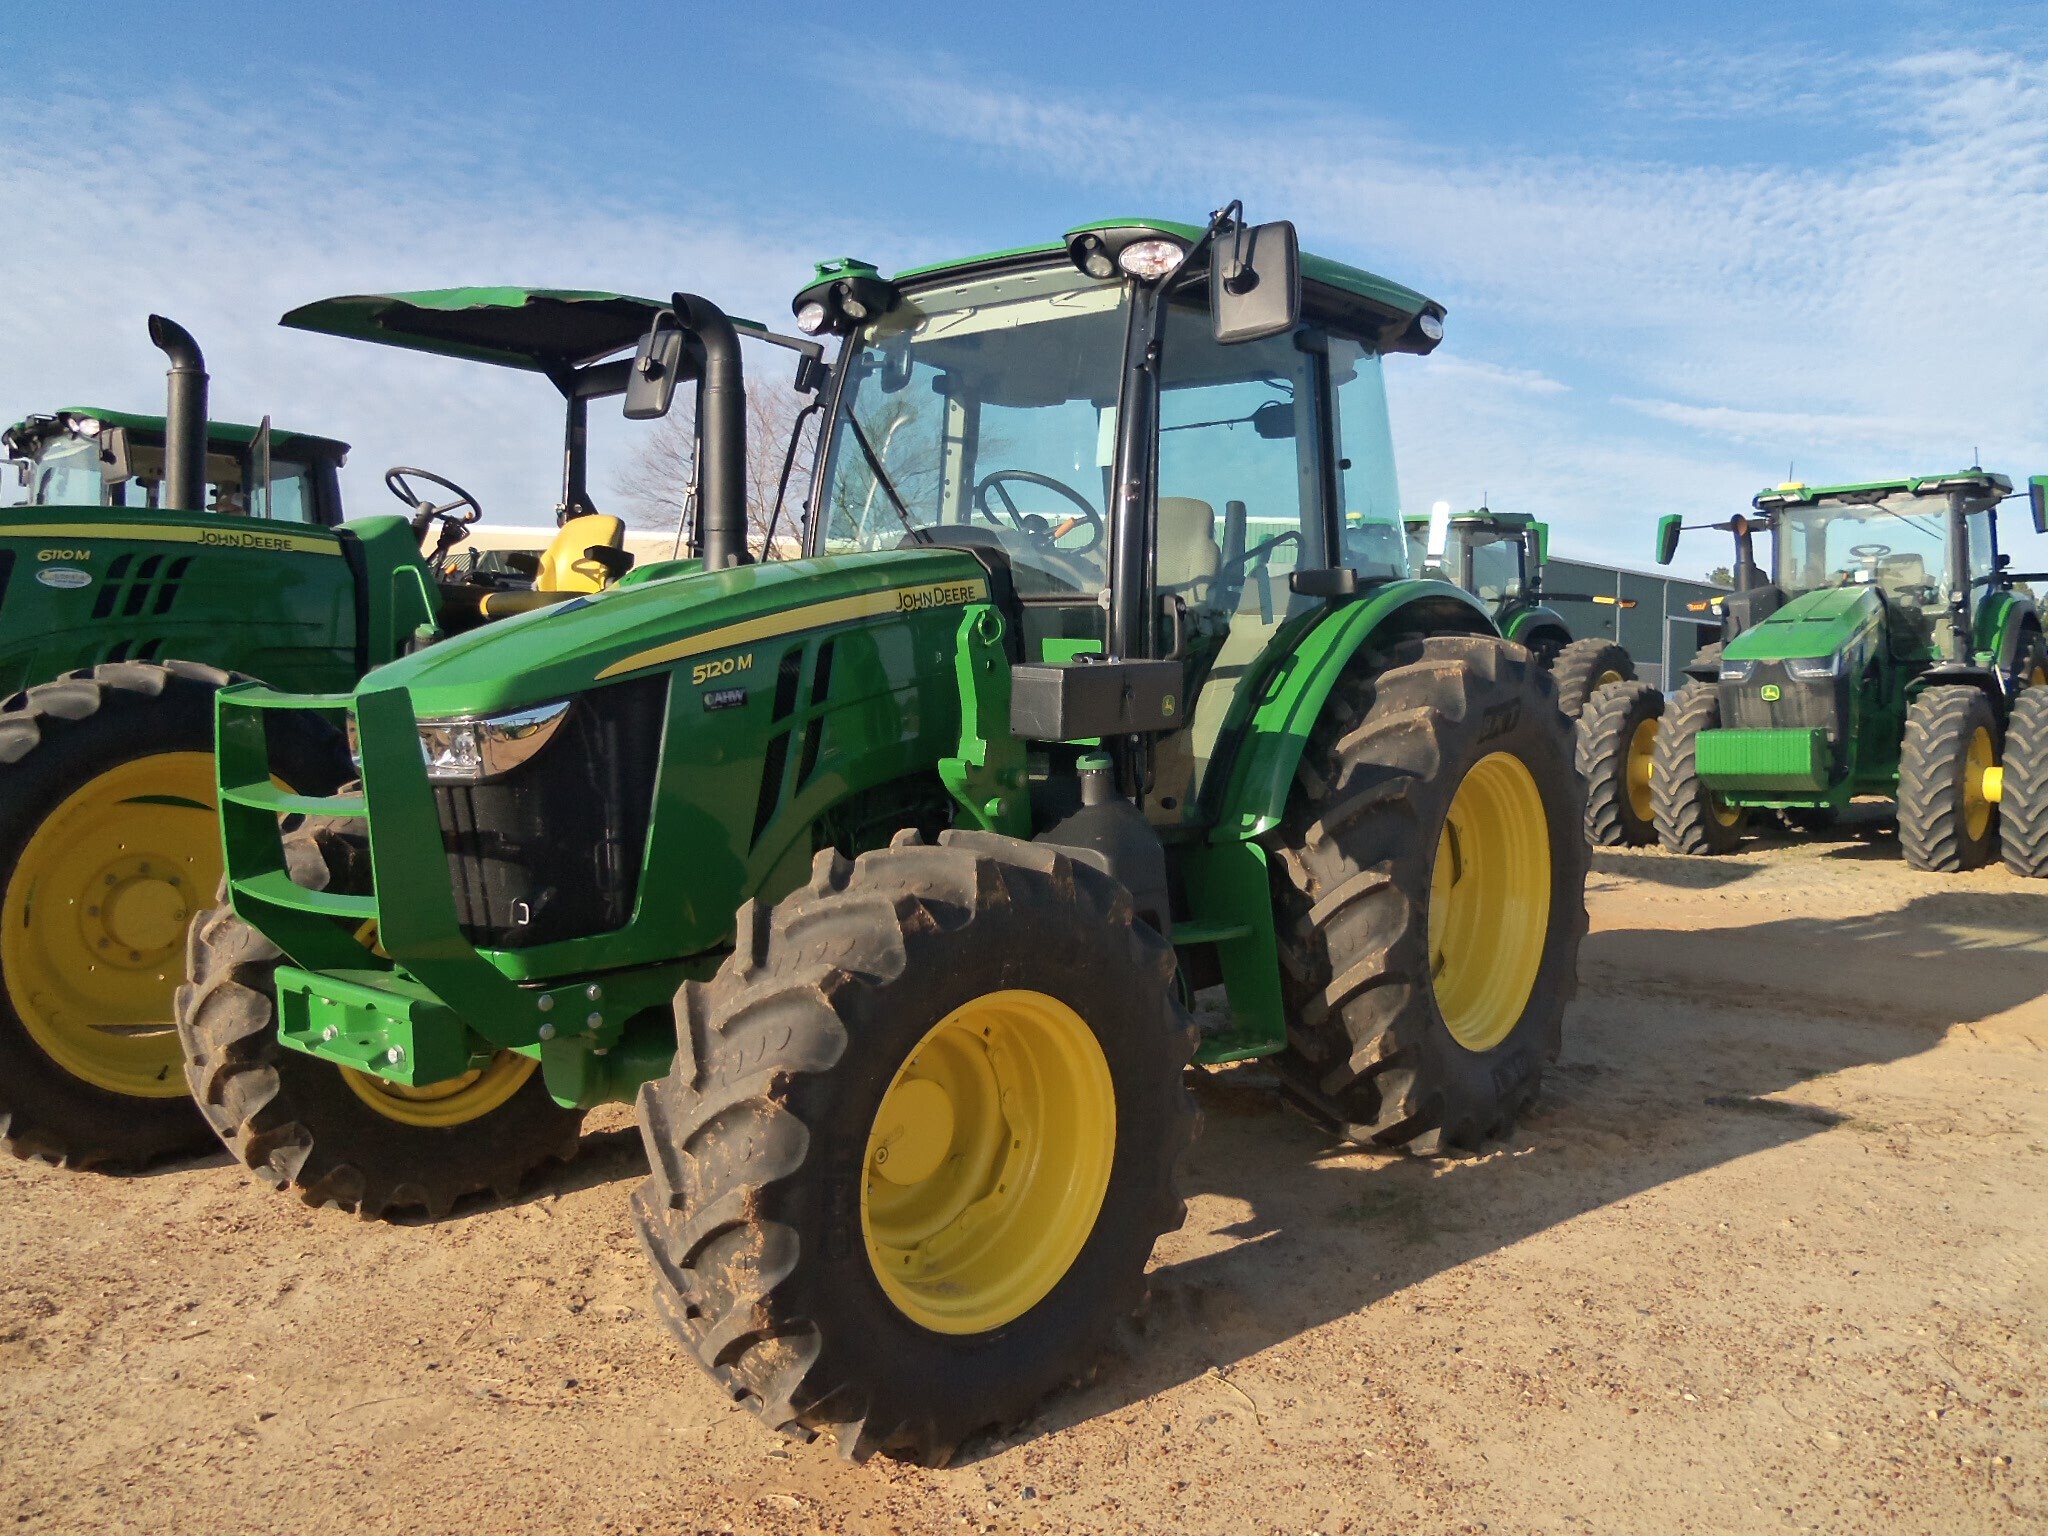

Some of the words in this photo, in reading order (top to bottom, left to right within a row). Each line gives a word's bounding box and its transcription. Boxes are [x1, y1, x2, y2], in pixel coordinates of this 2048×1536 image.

[197, 530, 240, 545] JOHN
[242, 533, 292, 550] DEERE
[895, 591, 933, 610] JOHN
[933, 586, 976, 604] DEERE
